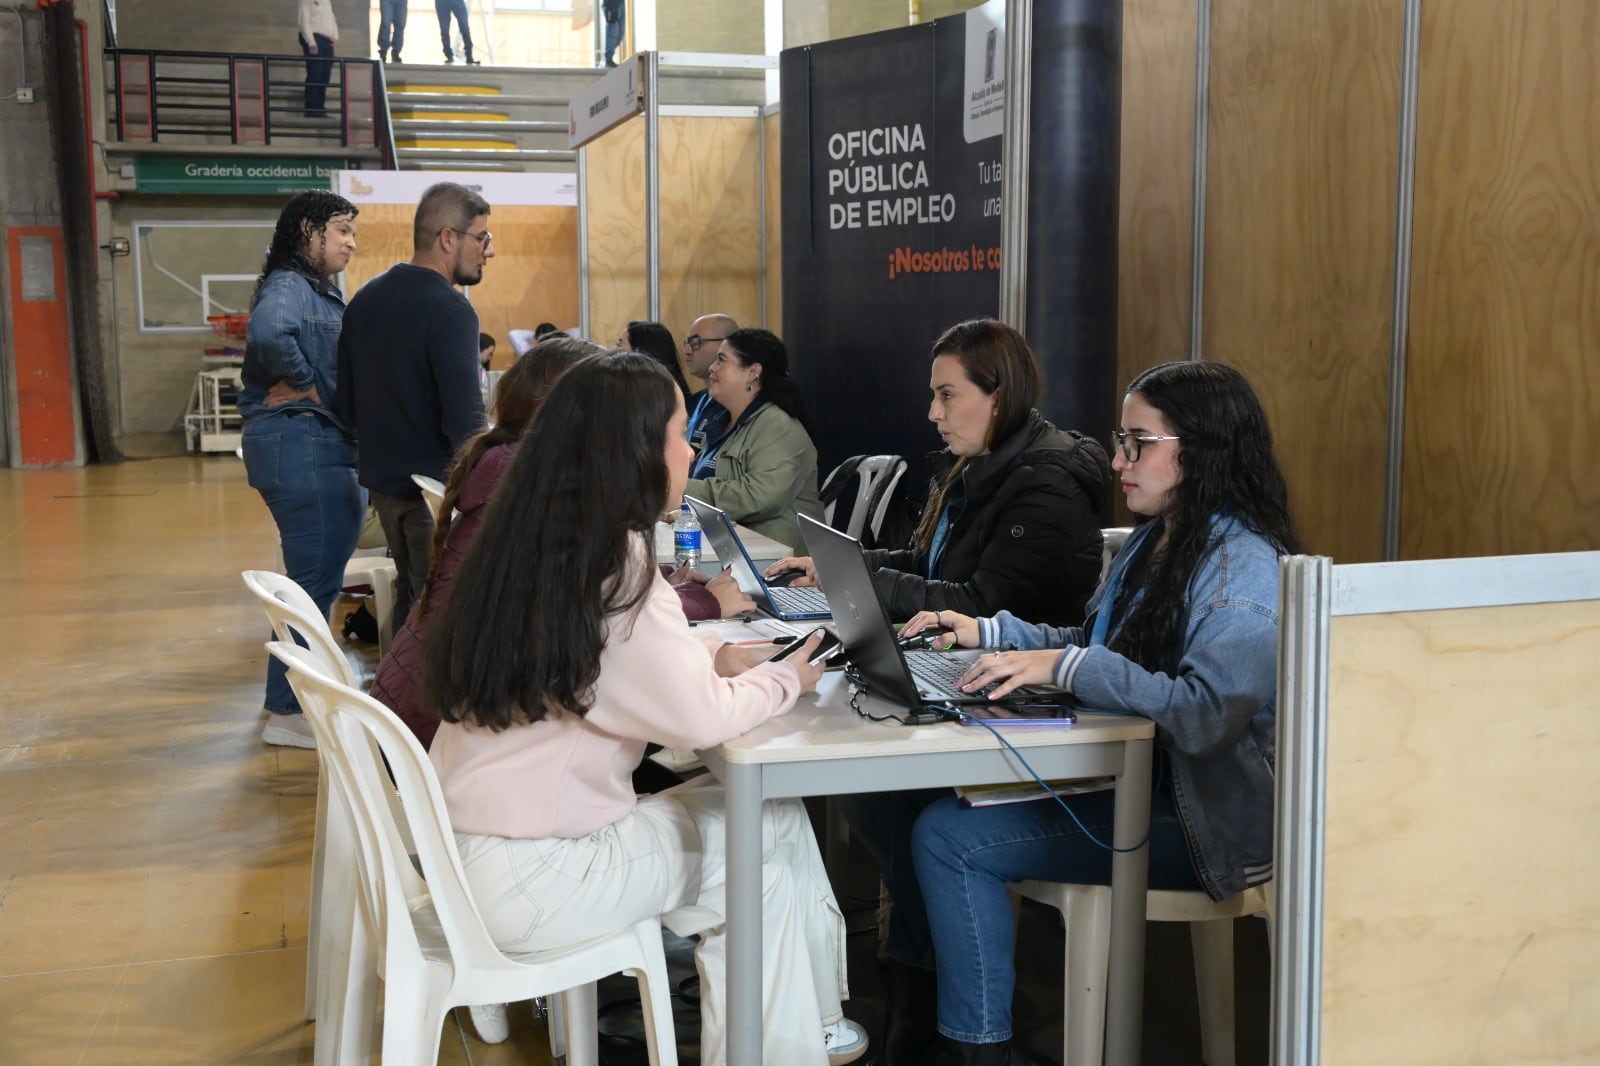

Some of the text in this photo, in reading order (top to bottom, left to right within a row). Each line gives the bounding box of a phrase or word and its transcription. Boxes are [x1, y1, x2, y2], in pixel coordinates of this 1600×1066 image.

[828, 123, 926, 160] OFICINA
[247, 165, 312, 178] occidental
[829, 160, 929, 195] PÚBLICA
[978, 161, 991, 184] Tu
[830, 193, 956, 229] DE EMPLEO
[889, 246, 969, 280] ¡Nosotros
[971, 243, 985, 271] te
